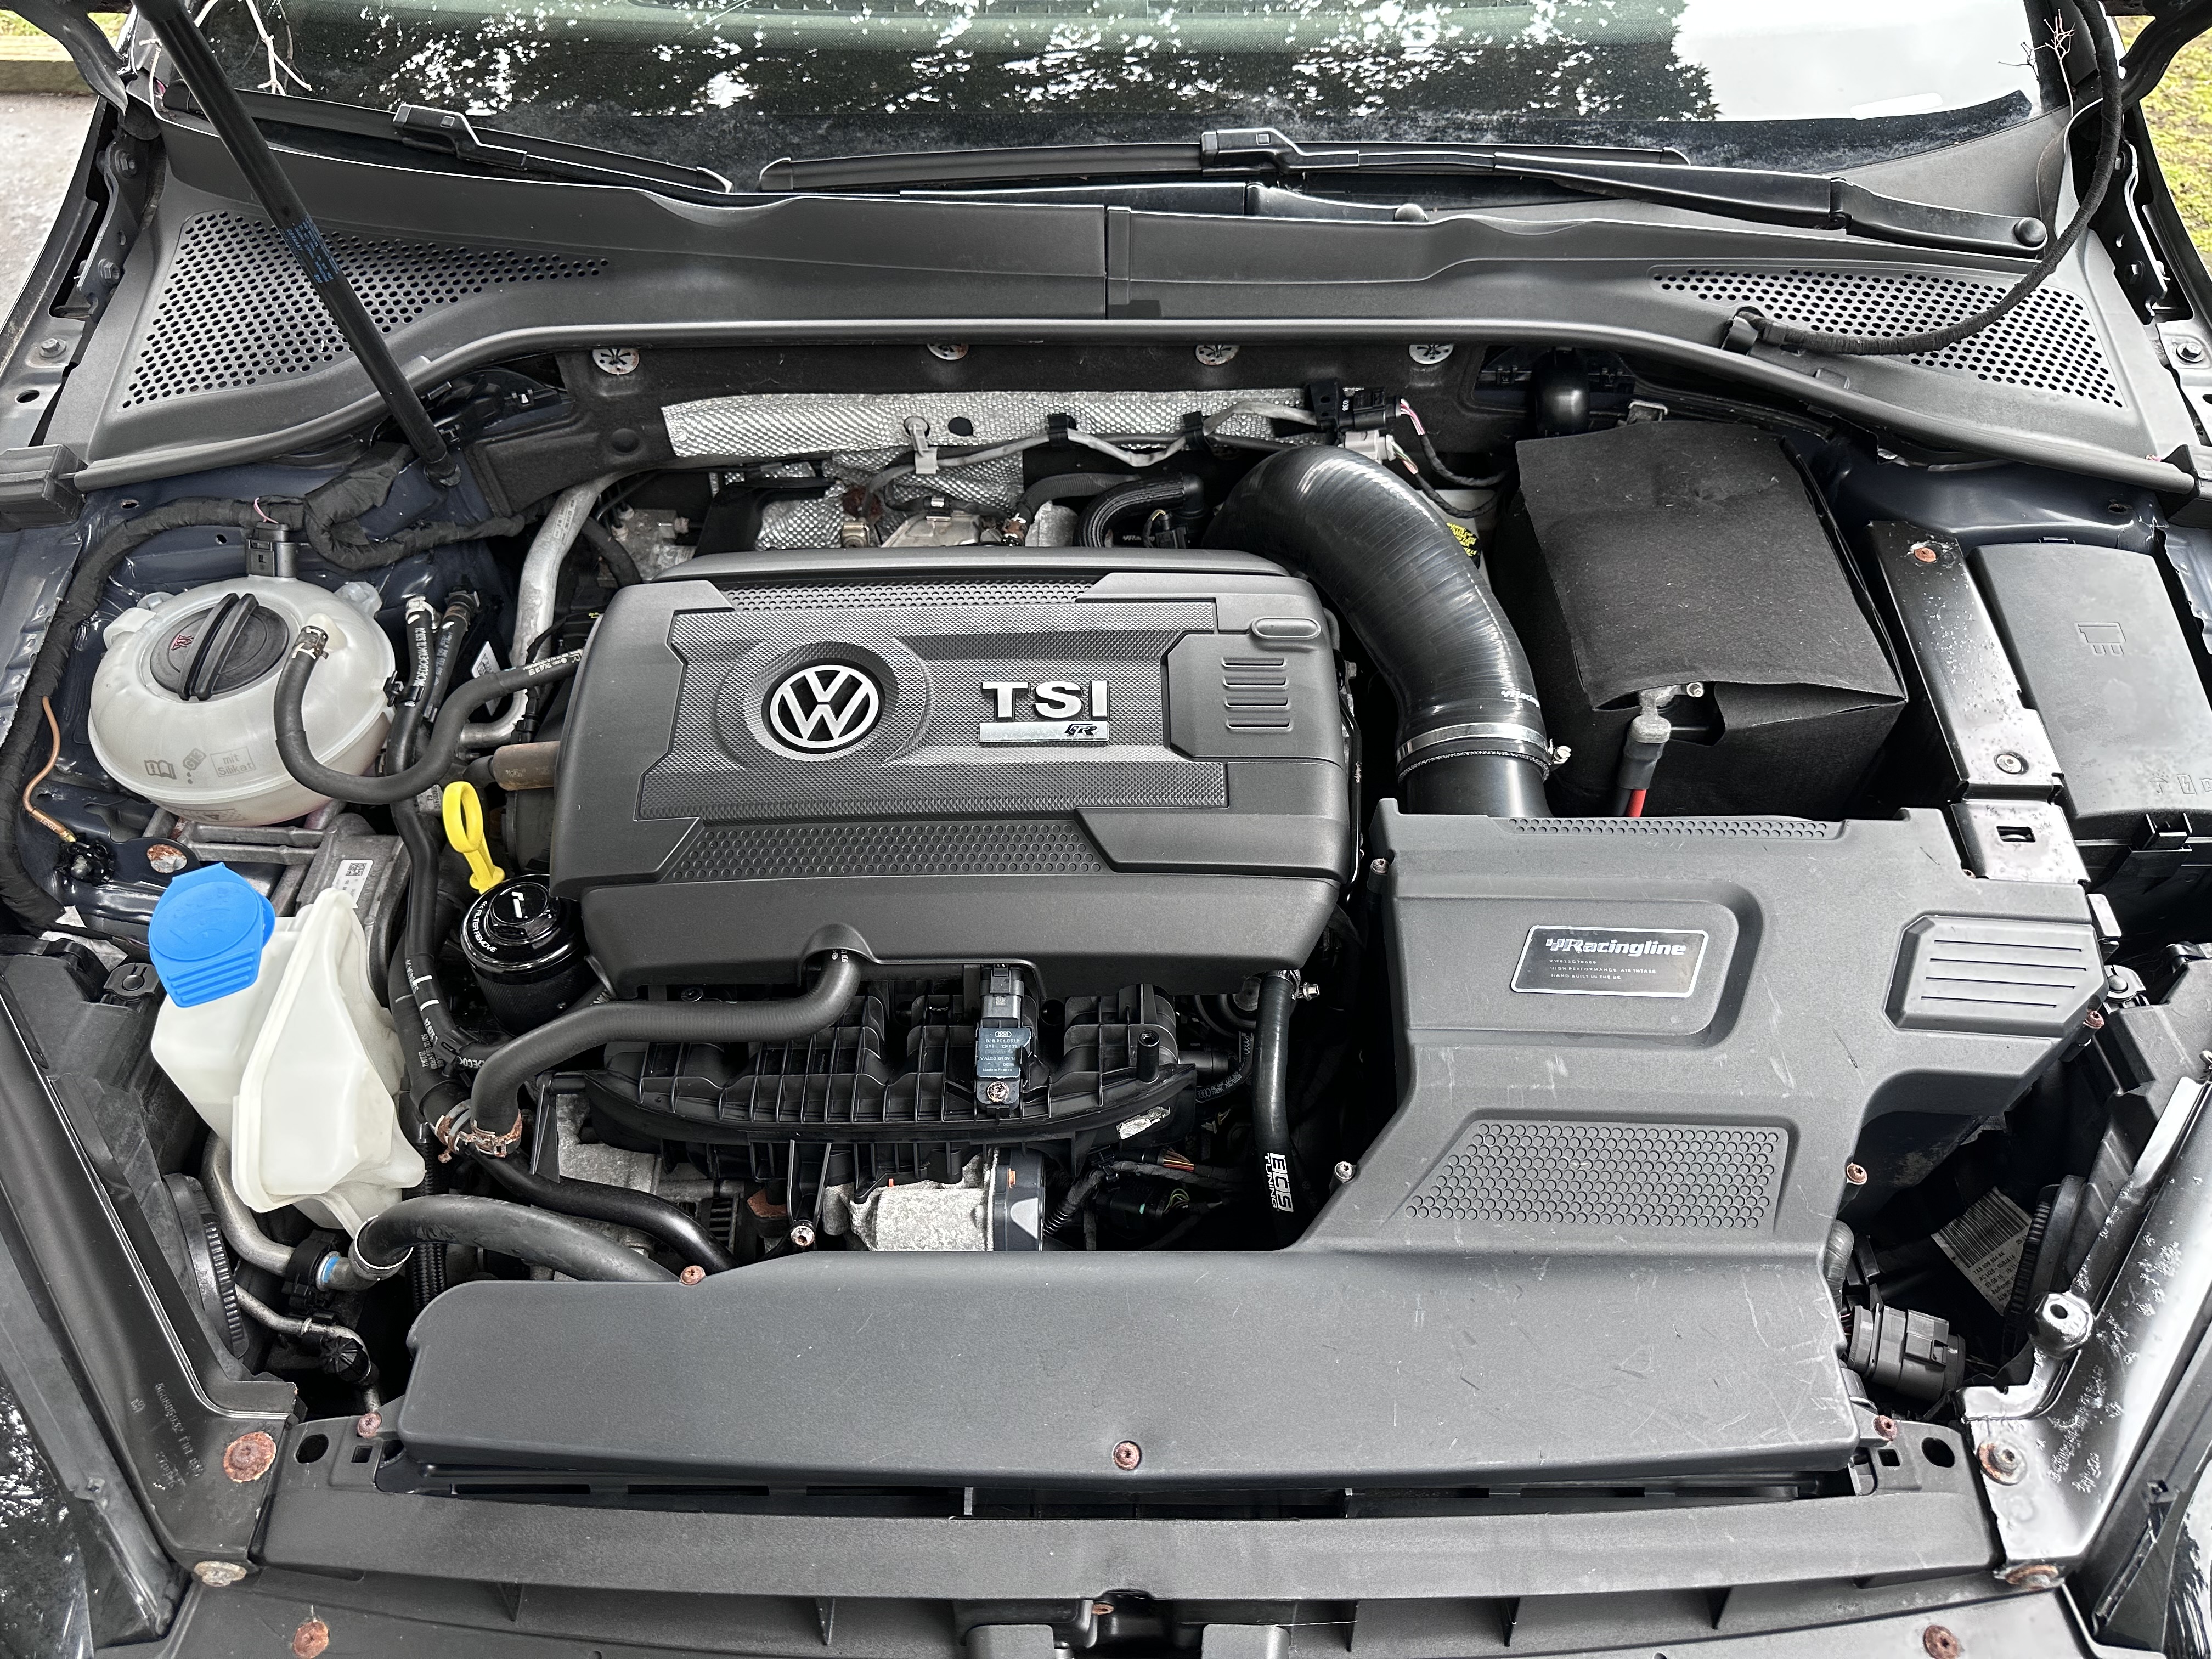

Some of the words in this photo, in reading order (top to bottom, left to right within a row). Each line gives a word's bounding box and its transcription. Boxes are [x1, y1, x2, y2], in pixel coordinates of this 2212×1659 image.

[770, 665, 879, 748] VW
[980, 681, 1109, 721] TSI
[185, 750, 204, 769] G13
[218, 762, 253, 776] Silikat
[223, 754, 240, 765] mit
[472, 910, 483, 931] FILTER
[473, 931, 498, 952] REMOVE
[1562, 938, 1686, 957] Racingline
[1265, 1153, 1277, 1209] TUNING
[1270, 1153, 1294, 1212] ECS
